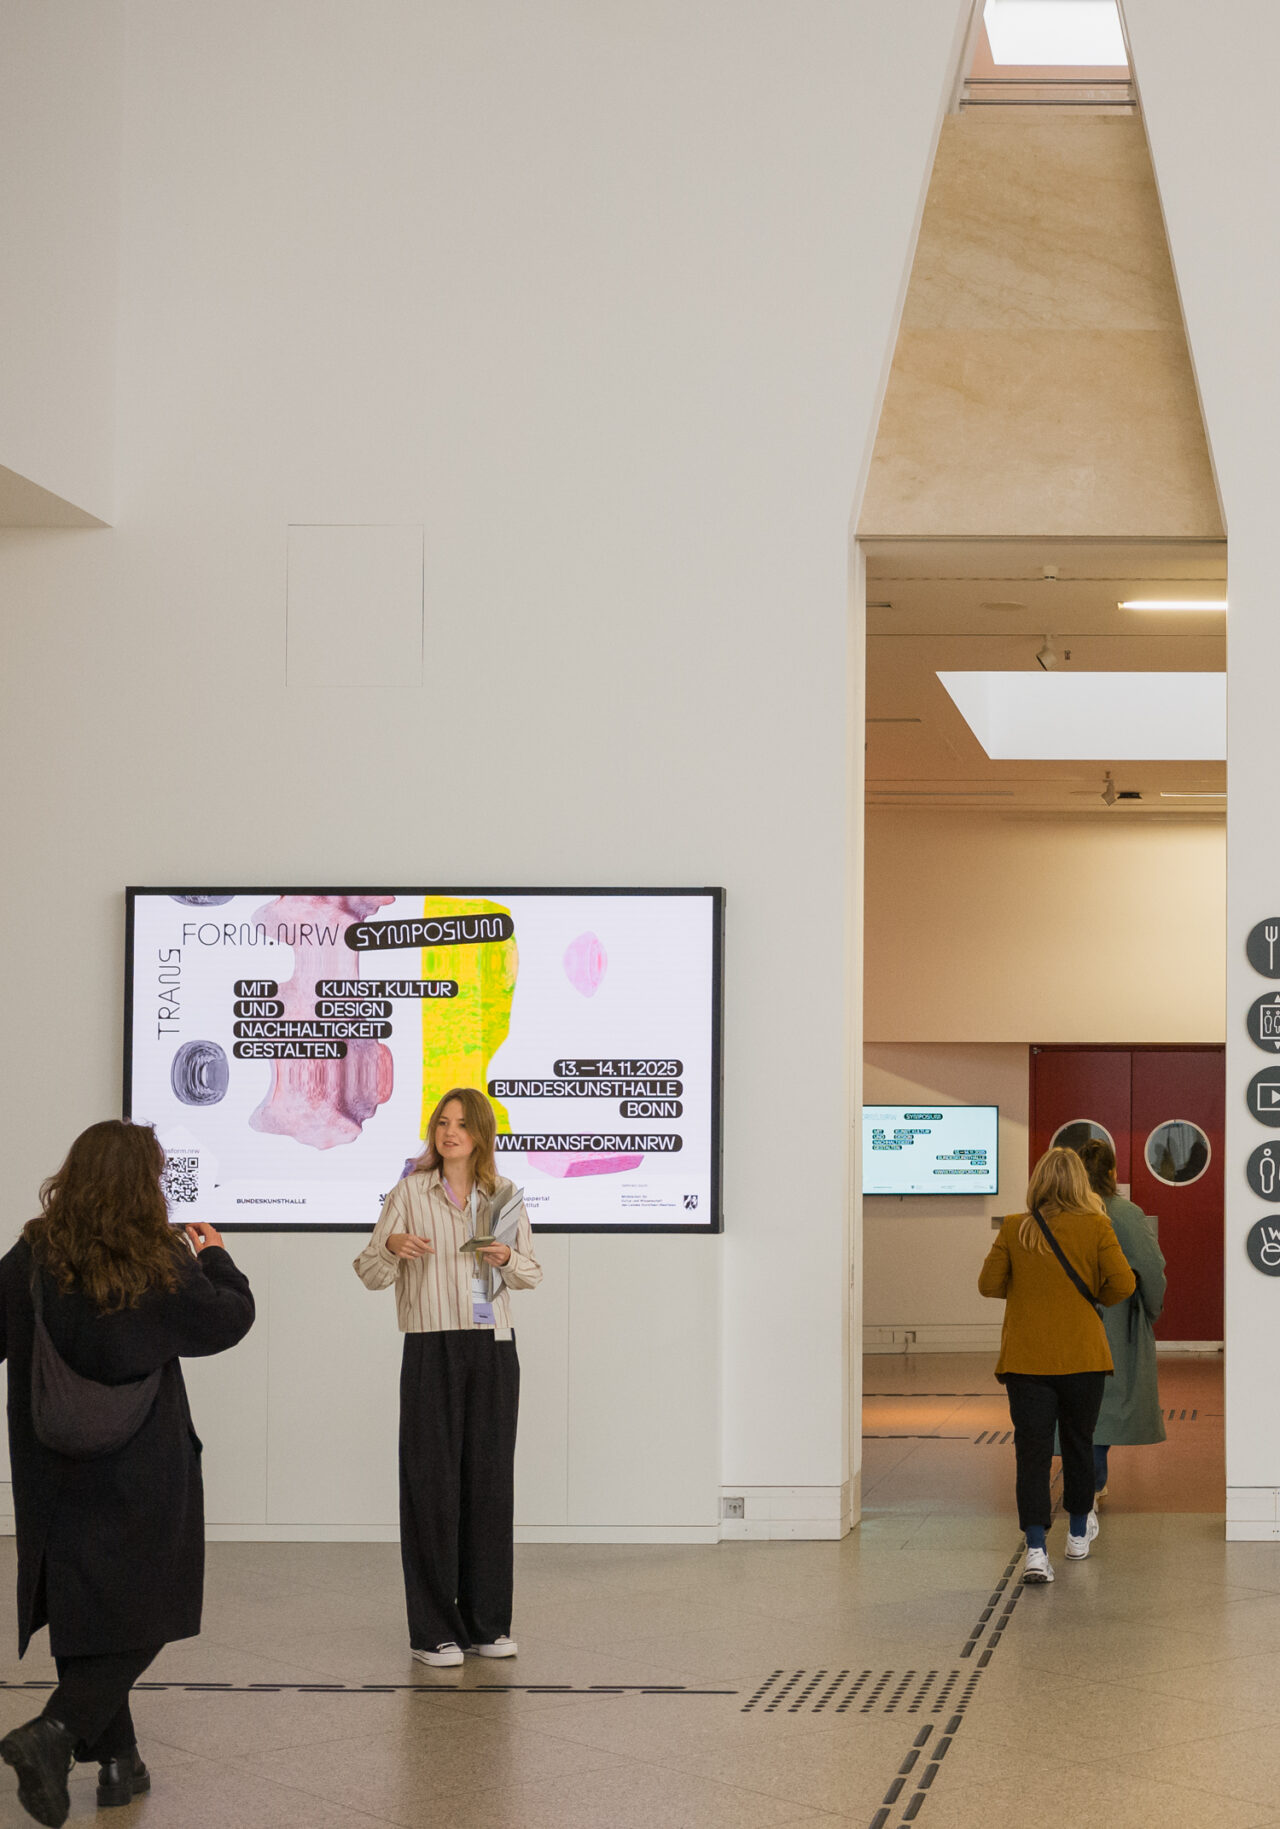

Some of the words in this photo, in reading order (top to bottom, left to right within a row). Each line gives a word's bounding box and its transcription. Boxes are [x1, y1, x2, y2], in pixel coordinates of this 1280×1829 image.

[183, 923, 340, 946] FORM.NRW
[355, 917, 504, 947] SYMPOSIUM
[157, 949, 181, 1041] TRANS
[240, 982, 272, 996] MIT
[322, 982, 382, 998] KUNST,
[385, 982, 452, 996] KULTUR
[240, 1002, 278, 1017] UND
[321, 1002, 385, 1017] DESIGN
[240, 1022, 386, 1037] NACHHALTIGKEIT
[239, 1042, 341, 1057] GESTALTEN.
[494, 1081, 677, 1096] BUNDESKUNSTHALLE
[627, 1102, 677, 1117] BONN
[495, 1136, 676, 1150] WW.TRANSFORM.NRW
